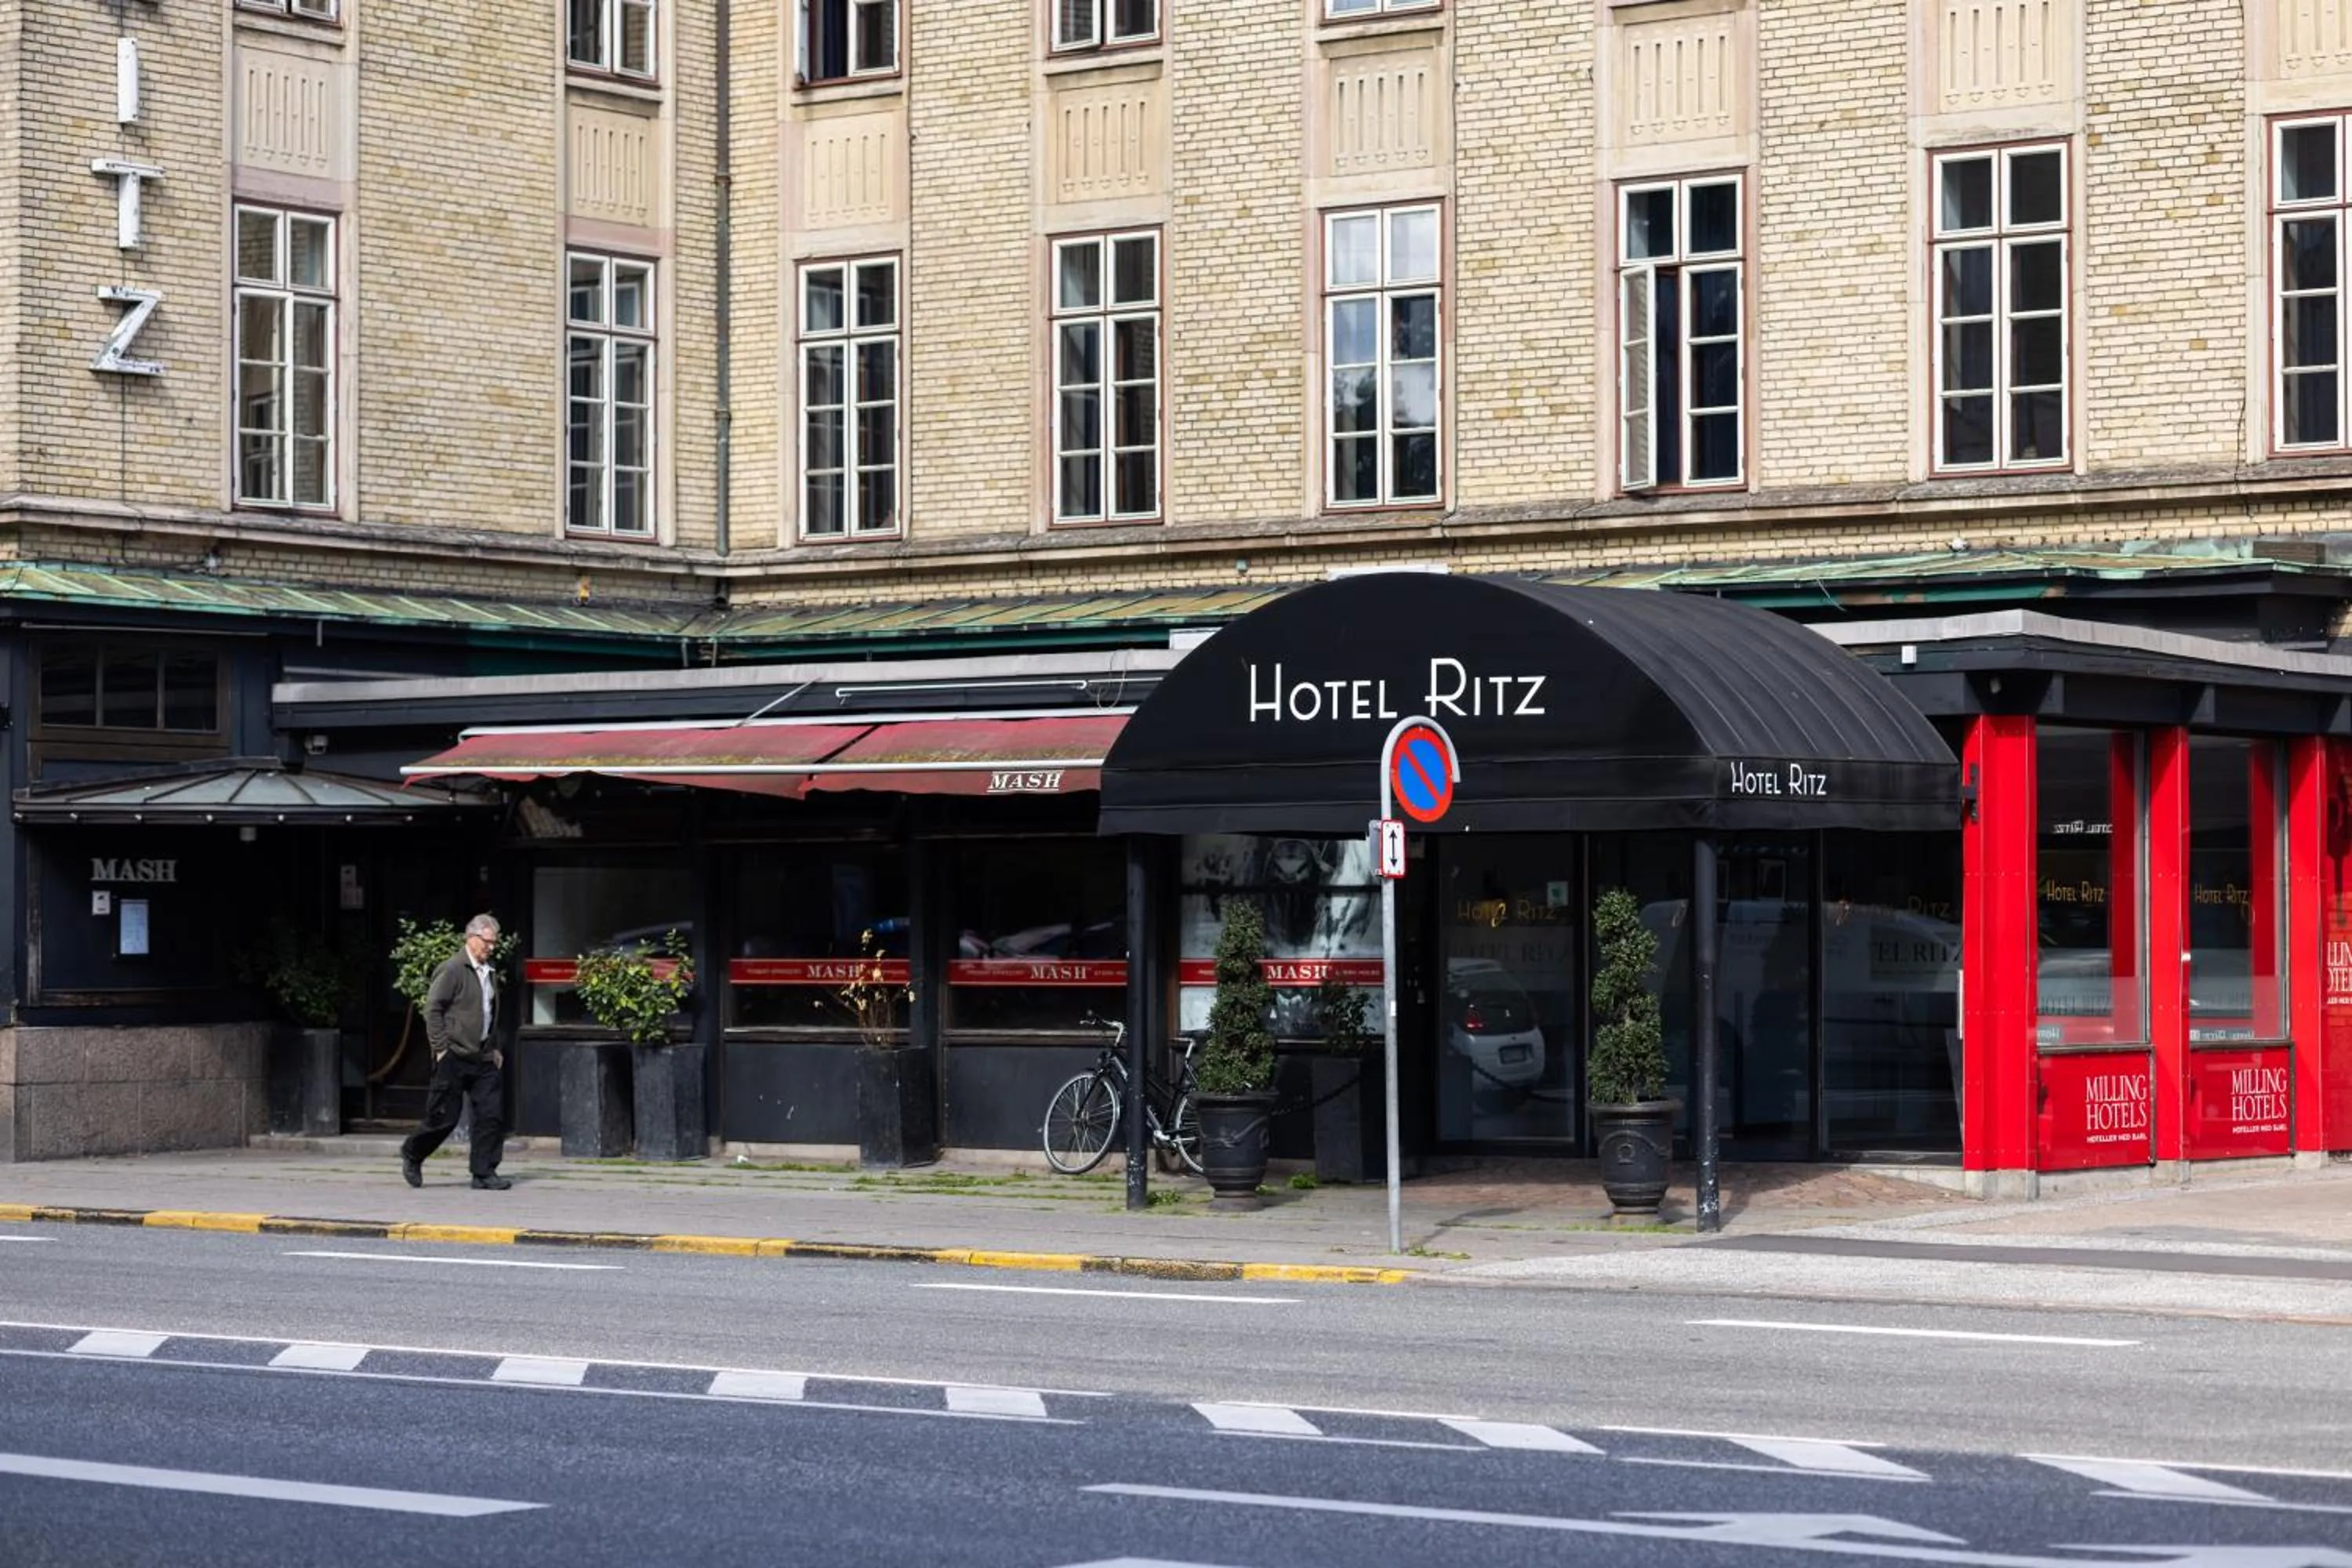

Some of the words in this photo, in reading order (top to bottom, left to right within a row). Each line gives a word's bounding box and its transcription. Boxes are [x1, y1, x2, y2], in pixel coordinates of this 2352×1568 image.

[90, 0, 167, 375] ITZ
[1250, 662, 1398, 721] HOTEL
[1425, 658, 1547, 717] RITZ
[987, 772, 1063, 790] MASH
[1730, 761, 1782, 794] HOTEL
[1788, 763, 1828, 796] RITZ
[89, 857, 179, 883] MASH
[2046, 879, 2077, 902] HOTEL
[2081, 880, 2105, 904] RITZ
[806, 964, 860, 978] MASH
[1030, 965, 1087, 979] MASH
[1266, 965, 1328, 979] MASH
[2085, 1075, 2147, 1103] MILLING
[2231, 1068, 2287, 1095] MILLING
[2085, 1102, 2147, 1130] HOTELS
[2231, 1094, 2287, 1122] HOTELS
